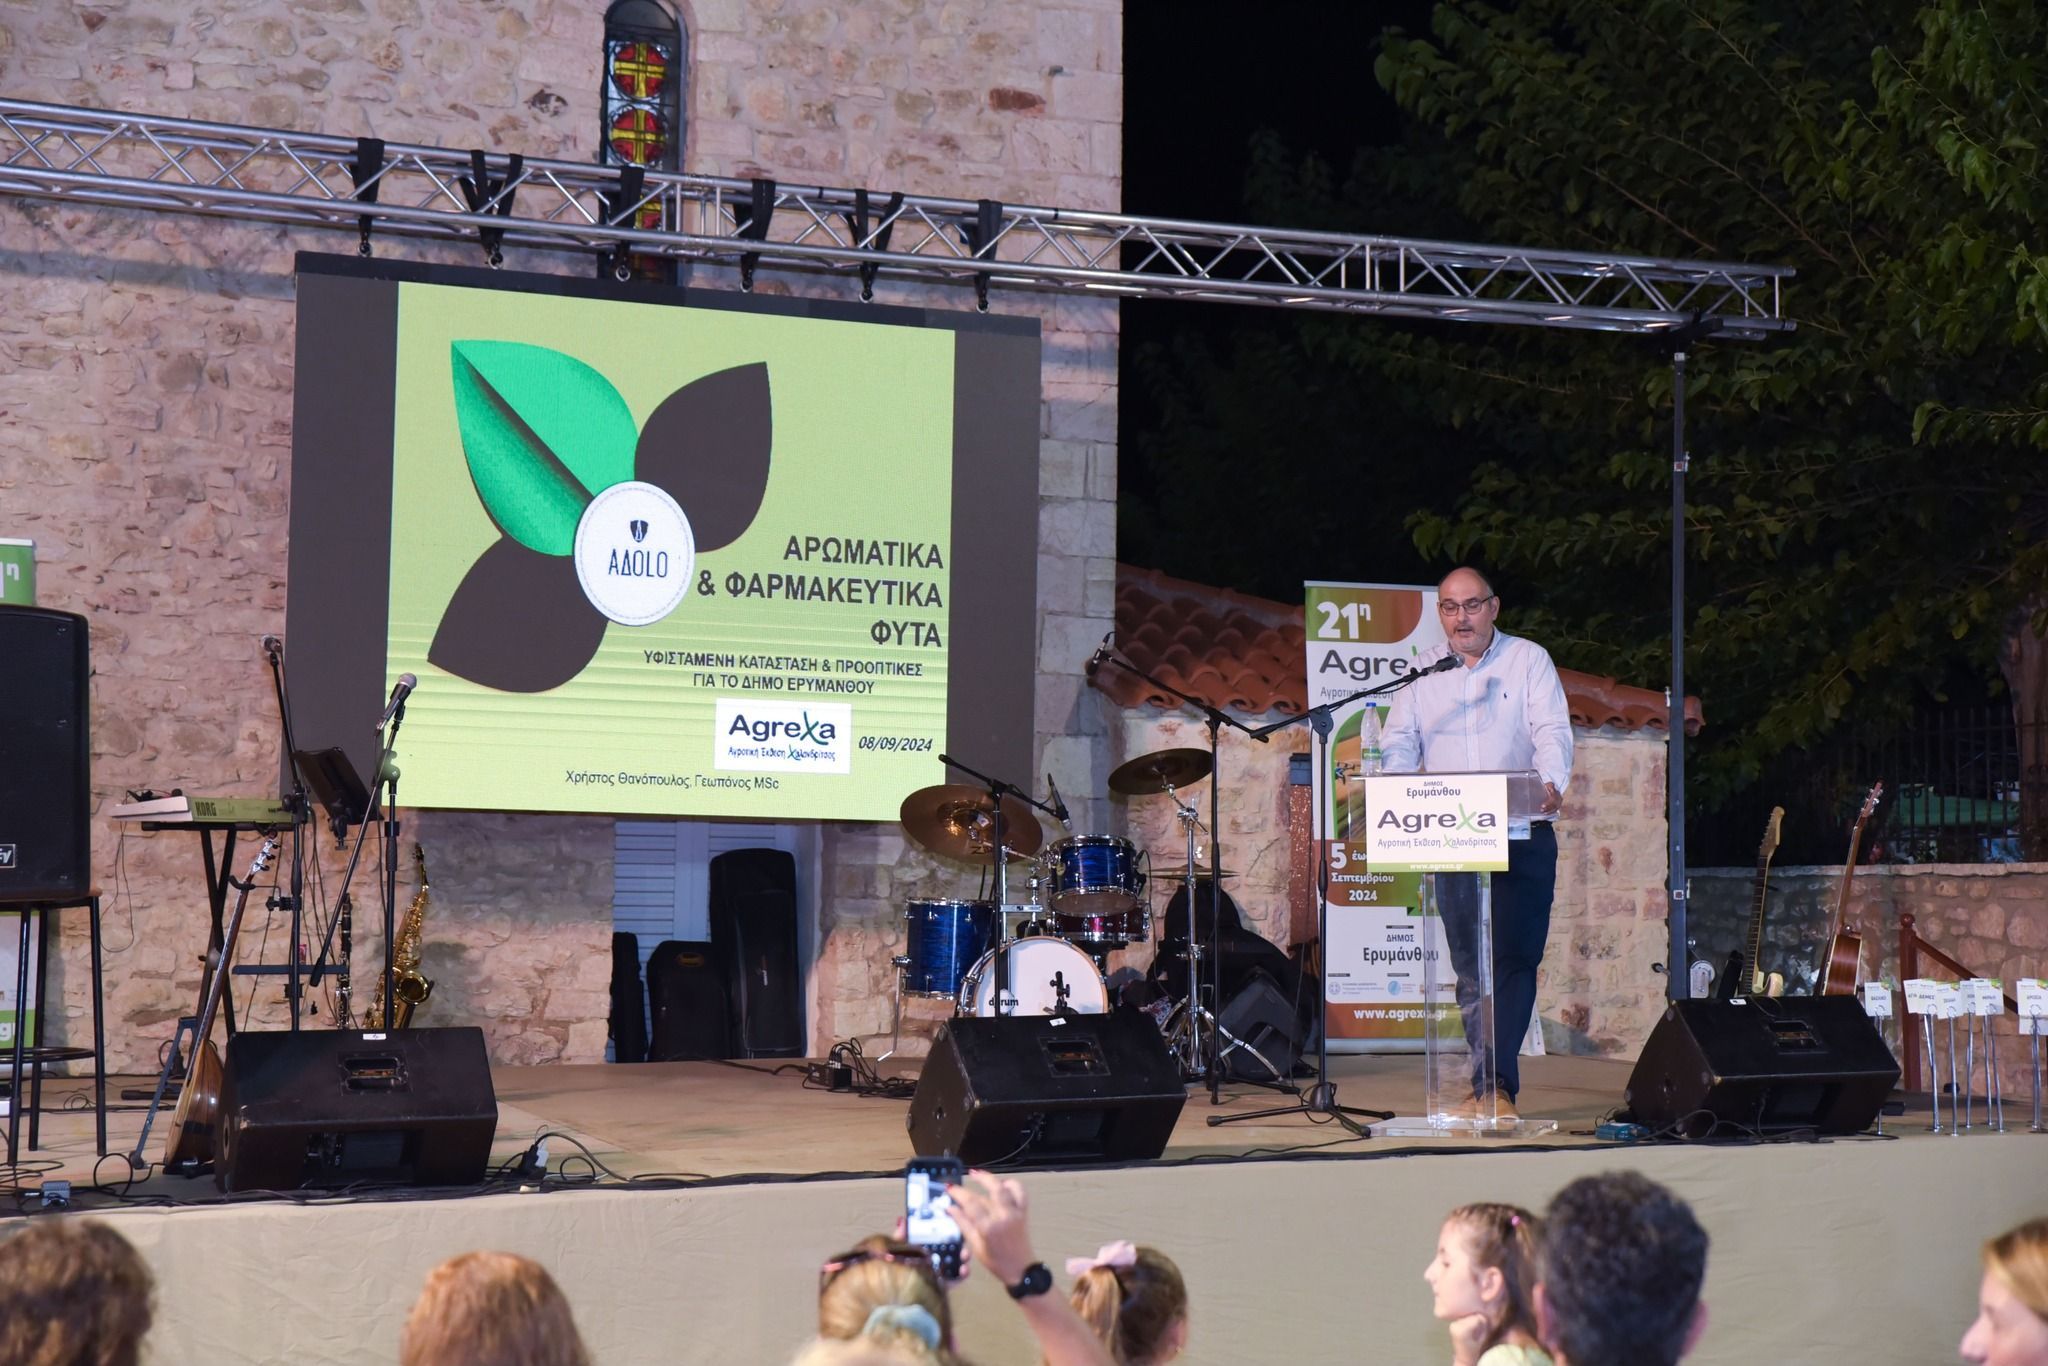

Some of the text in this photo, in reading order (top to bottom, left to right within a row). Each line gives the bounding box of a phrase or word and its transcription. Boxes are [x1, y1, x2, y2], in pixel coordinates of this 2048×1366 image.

[783, 535, 944, 569] ΑΡΩΜΑΤΙΚΑ
[696, 569, 944, 608] & ΦΑΡΜΑΚΕΥΤΙΚΑ
[870, 619, 942, 647] ΦΥΤΑ
[644, 649, 923, 677] ΥΦΙΣΤΑΜΕΝΗ ΚΑΤΑΣΤΑΣΗ & ΠΡΟΟΠΤΙΚΕΣ
[693, 673, 875, 695] ΓΙΑ ΤΟ ΔΗΜΟ ΕΡΥΜΑΝΘΟΥ
[858, 736, 933, 752] 08/09/2024
[566, 771, 779, 791] Χρήστος Θανόπουλος, Γεωπόνος MSc
[1406, 787, 1461, 799] Ερυμάνθου
[195, 801, 217, 817] KORG
[1377, 839, 1411, 849] Αγροτική
[1330, 842, 1367, 869] 5 έω
[1331, 872, 1394, 884] Σεπτεμβρίου
[1349, 889, 1377, 901] 2024
[1386, 934, 1415, 943] ΔΗΜΟΣ
